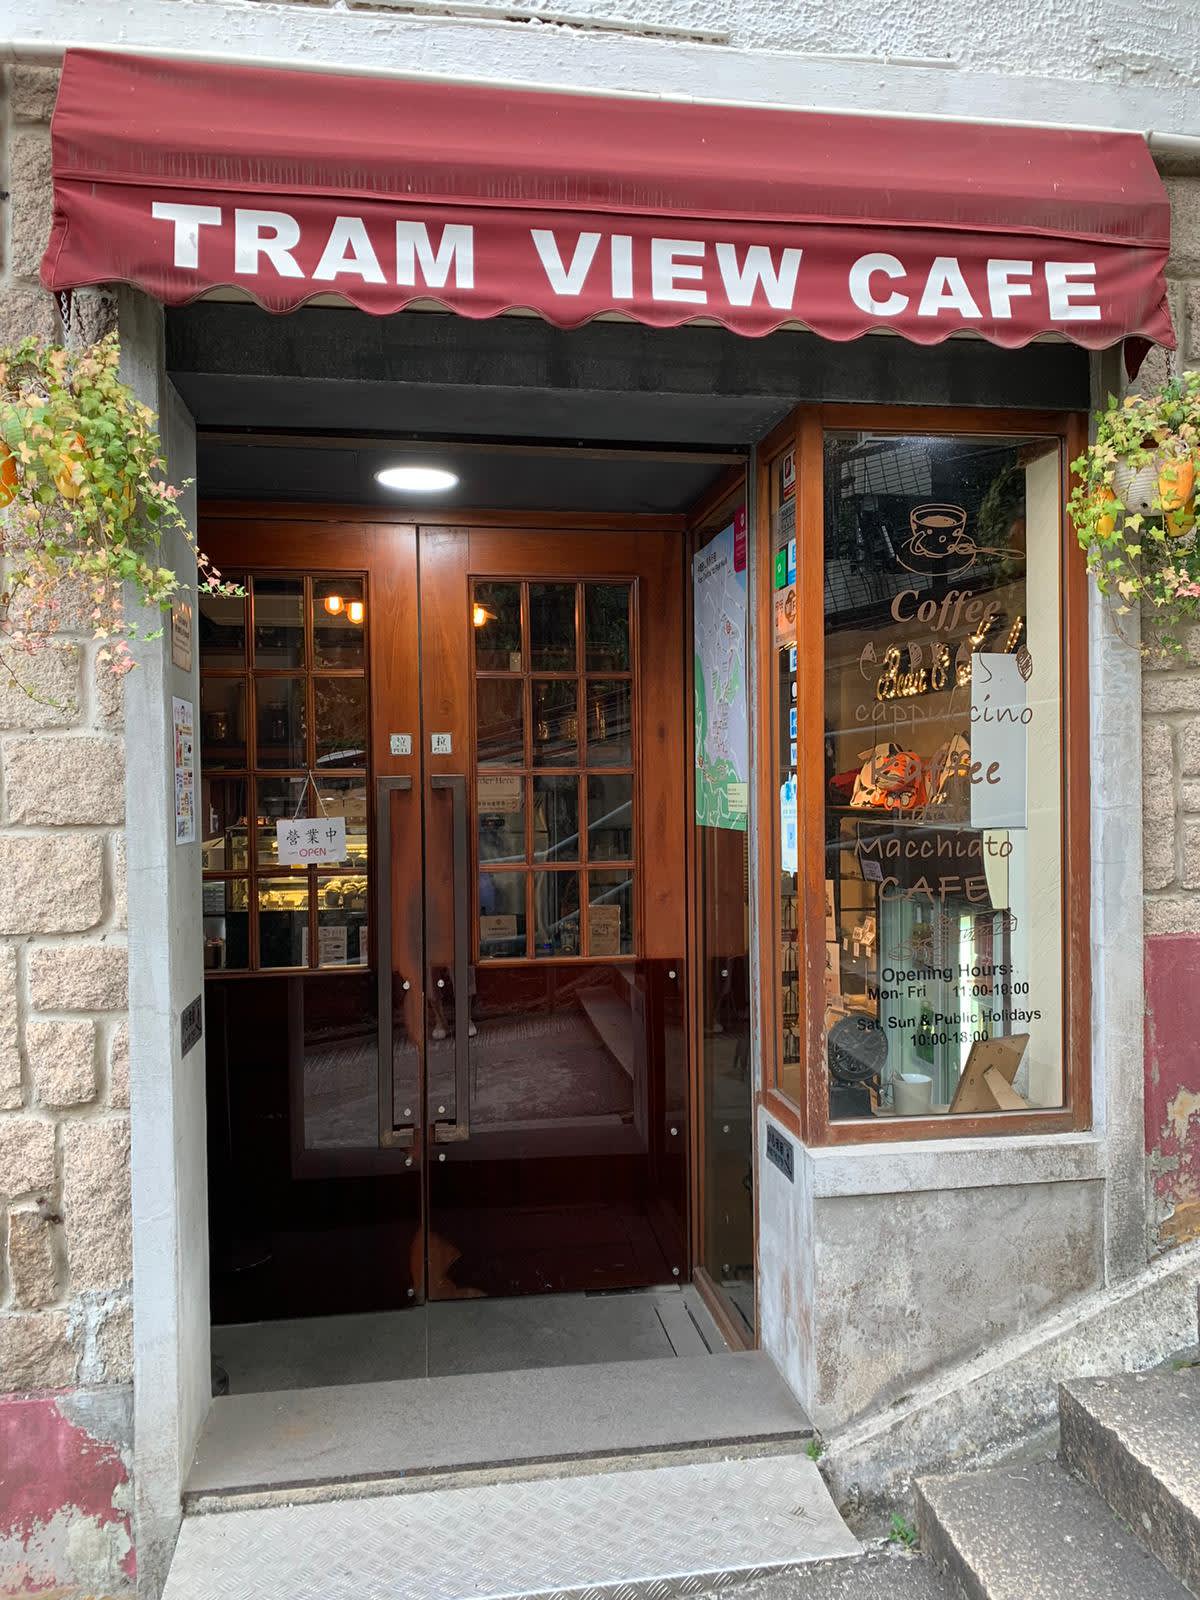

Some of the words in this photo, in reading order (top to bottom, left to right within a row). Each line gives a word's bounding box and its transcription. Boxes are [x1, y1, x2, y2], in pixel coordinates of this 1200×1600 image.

[152, 201, 474, 289] TRAM
[529, 228, 803, 311] VIEW
[848, 251, 1102, 322] CAFE
[890, 588, 1002, 632] Coffee
[286, 827, 337, 846] 營業中
[853, 827, 1013, 859] Macchiato
[299, 848, 327, 857] OPEN
[878, 875, 989, 904] CAFE
[881, 966, 953, 985] Opening
[958, 963, 1014, 978] Hours:
[907, 984, 927, 998] Fri
[952, 982, 1030, 997] 11:00-18:00
[888, 1015, 916, 1029] Sun
[920, 1013, 931, 1026] &
[934, 1010, 978, 1026] Public
[982, 1008, 1042, 1024] Holidays
[910, 1030, 989, 1047] 10:00-18:00
